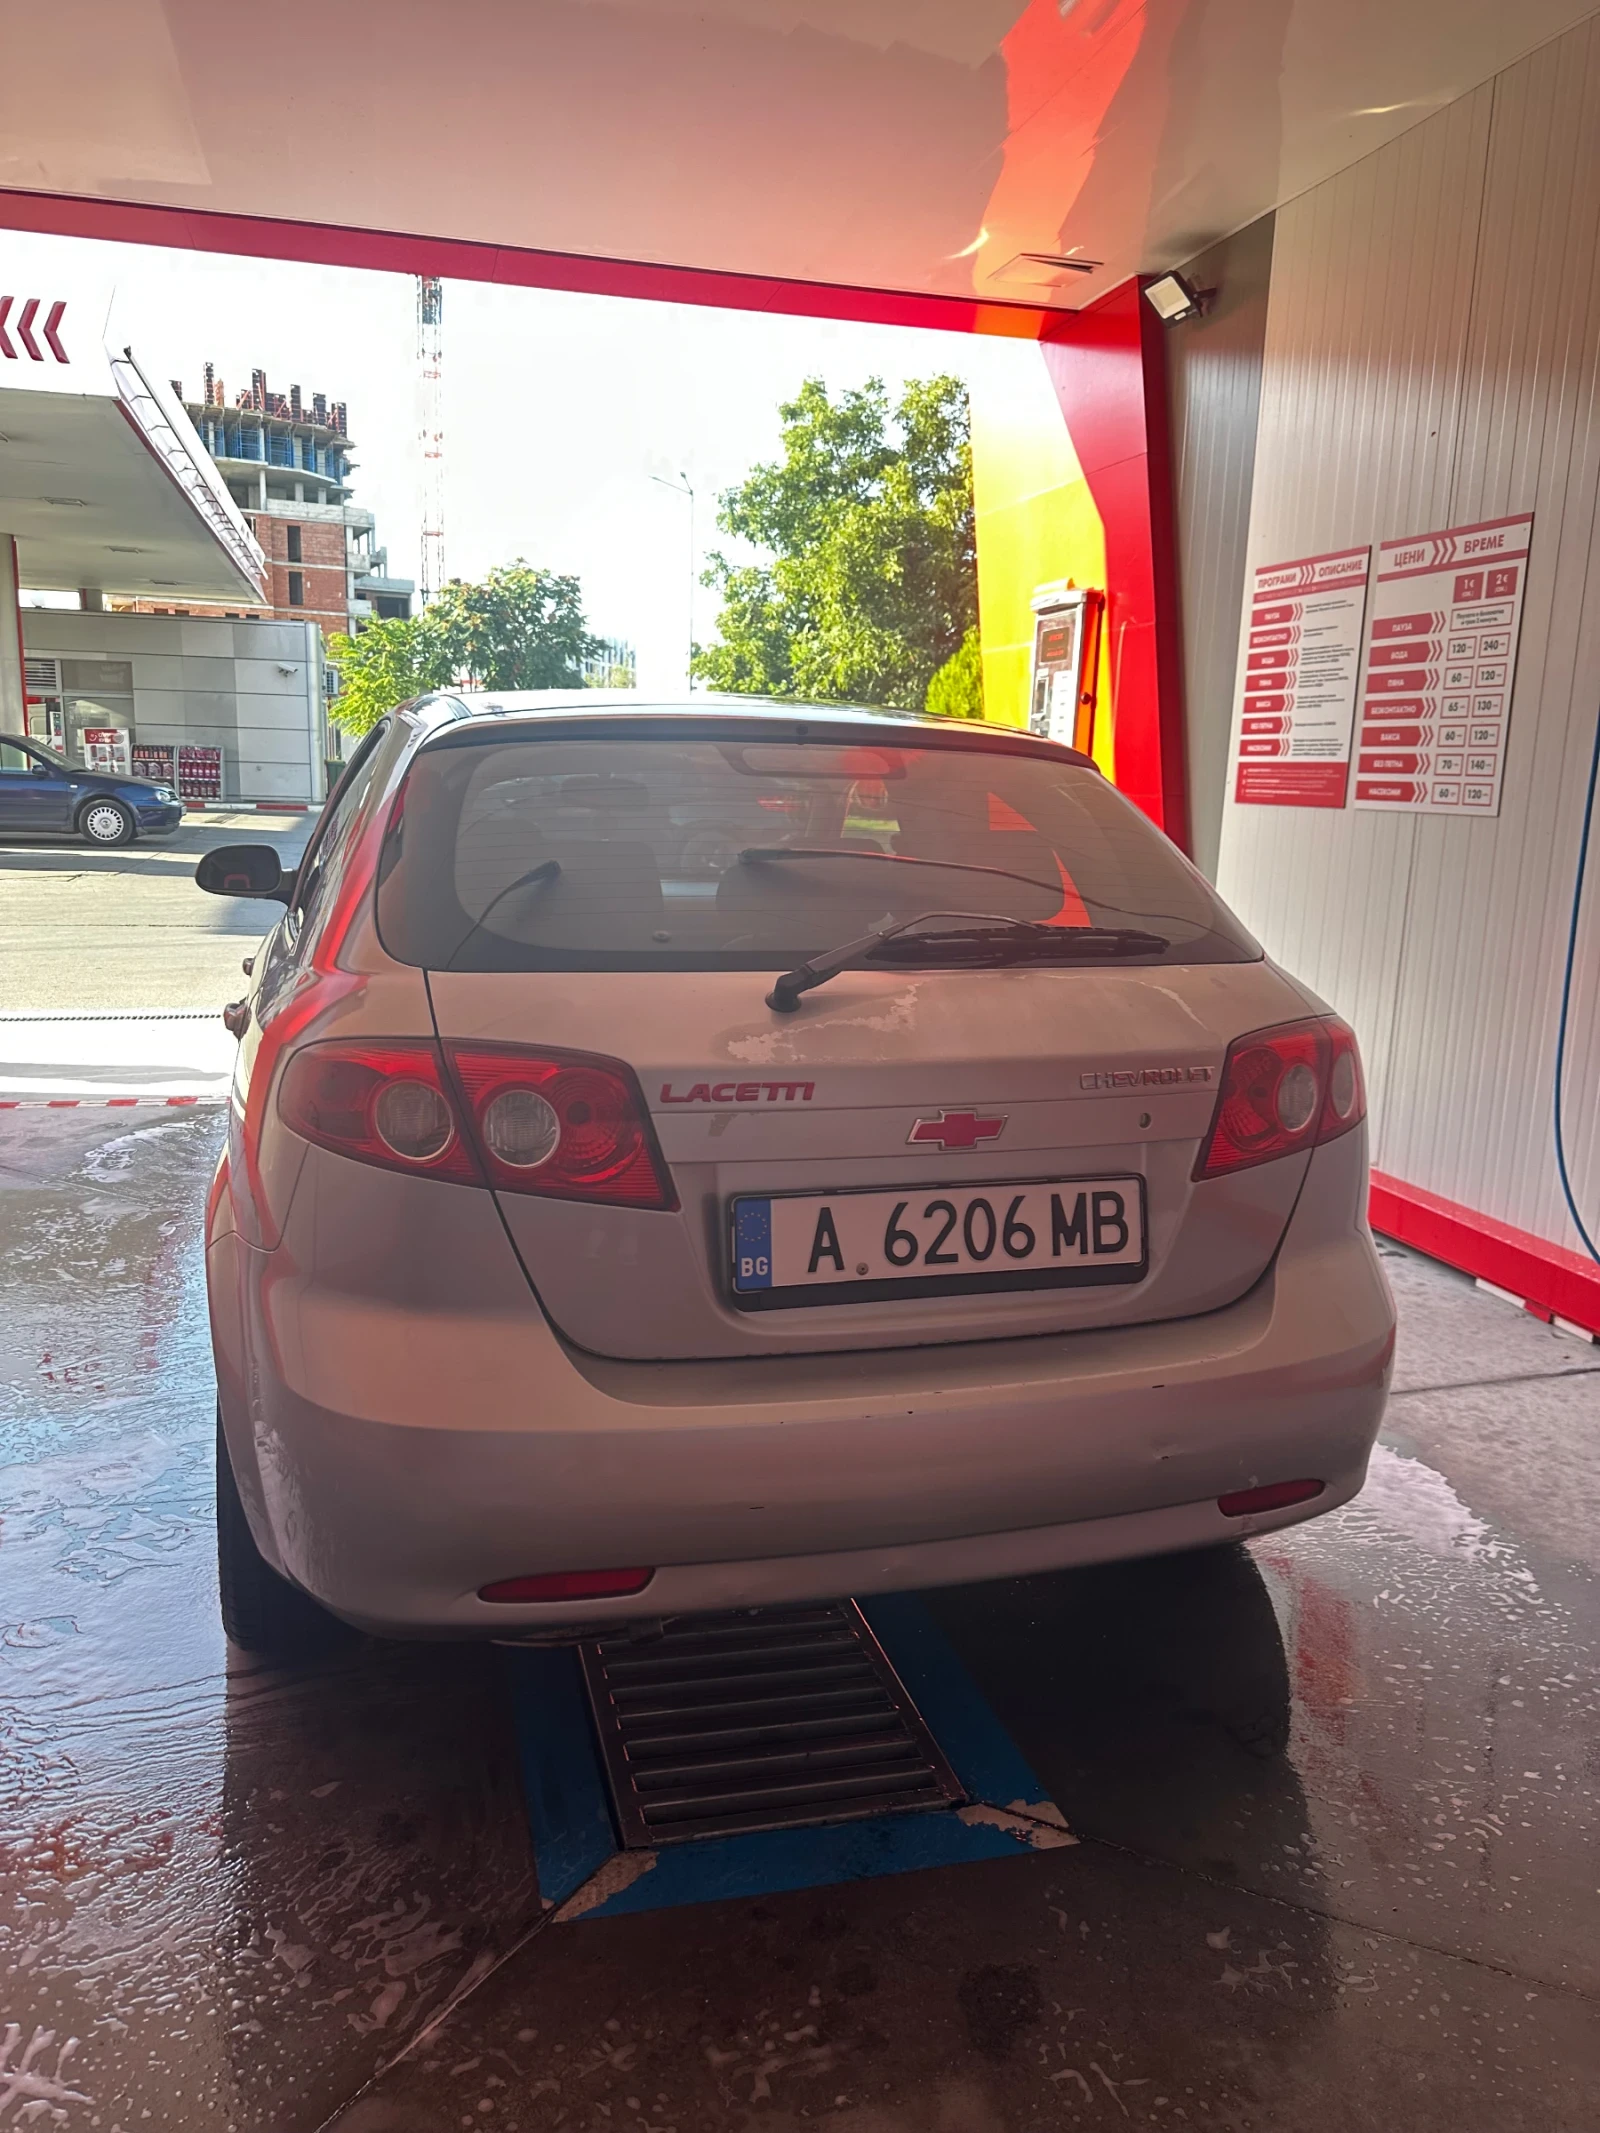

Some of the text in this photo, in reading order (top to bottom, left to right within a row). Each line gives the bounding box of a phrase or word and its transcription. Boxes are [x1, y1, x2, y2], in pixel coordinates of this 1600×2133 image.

[1394, 534, 1505, 568] ЦЕНИ ВРЕМЕ
[1258, 560, 1363, 588] ПРОГРАМИ ОПИСАНИЕ
[1452, 643, 1466, 653] 120
[1483, 640, 1499, 651] 240
[1451, 673, 1462, 683] 60
[1481, 670, 1495, 681] 120
[1448, 702, 1459, 712] 65
[1477, 700, 1492, 710] 130
[1445, 731, 1455, 741] 60
[1474, 730, 1488, 741] 120
[1441, 760, 1452, 770] 70
[1471, 760, 1485, 770] 140
[1439, 788, 1449, 798] 60
[1467, 789, 1482, 799] 120
[1080, 1066, 1215, 1090] CHEVROLET
[660, 1082, 815, 1103] LACETTI
[807, 1190, 1129, 1273] A 6206 MB
[741, 1257, 769, 1278] BG
